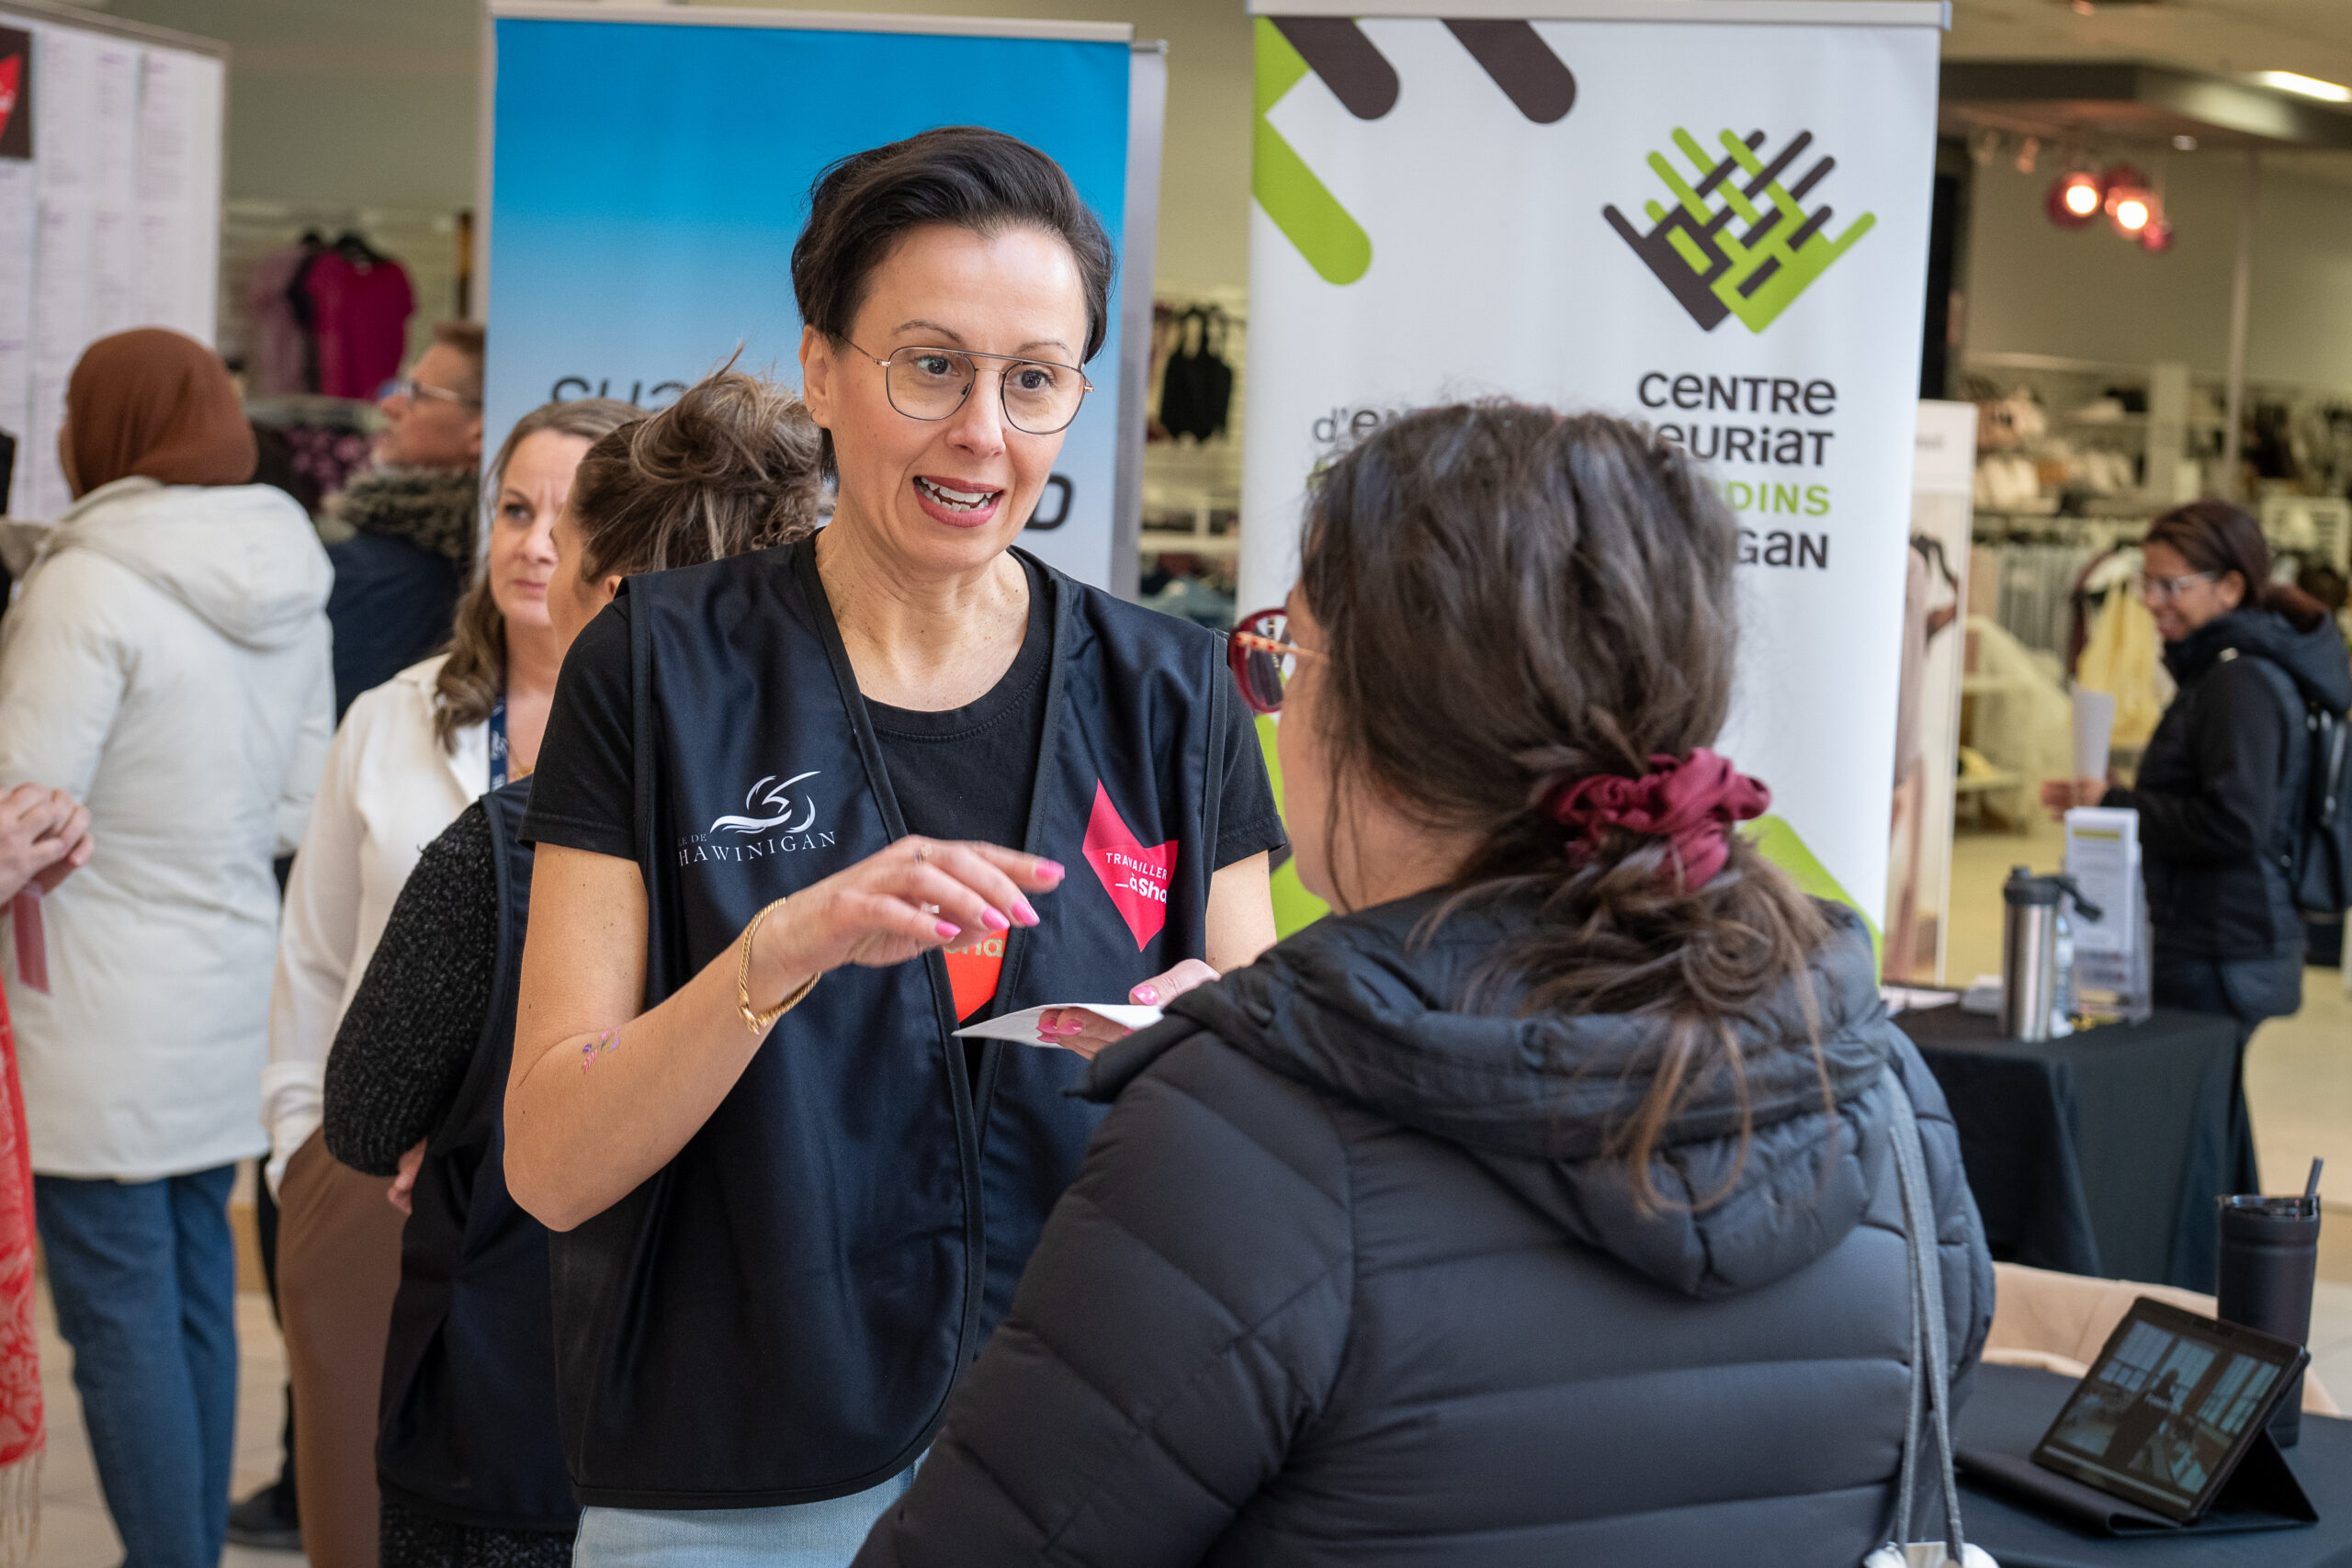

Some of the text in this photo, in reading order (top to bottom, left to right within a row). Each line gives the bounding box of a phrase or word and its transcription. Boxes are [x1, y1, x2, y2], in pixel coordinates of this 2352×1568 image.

[1639, 372, 1837, 416] CeNTRe
[1657, 423, 1835, 467] eURiaT
[1722, 480, 1831, 517] DINS
[1105, 852, 1168, 881] TRAVAILLER
